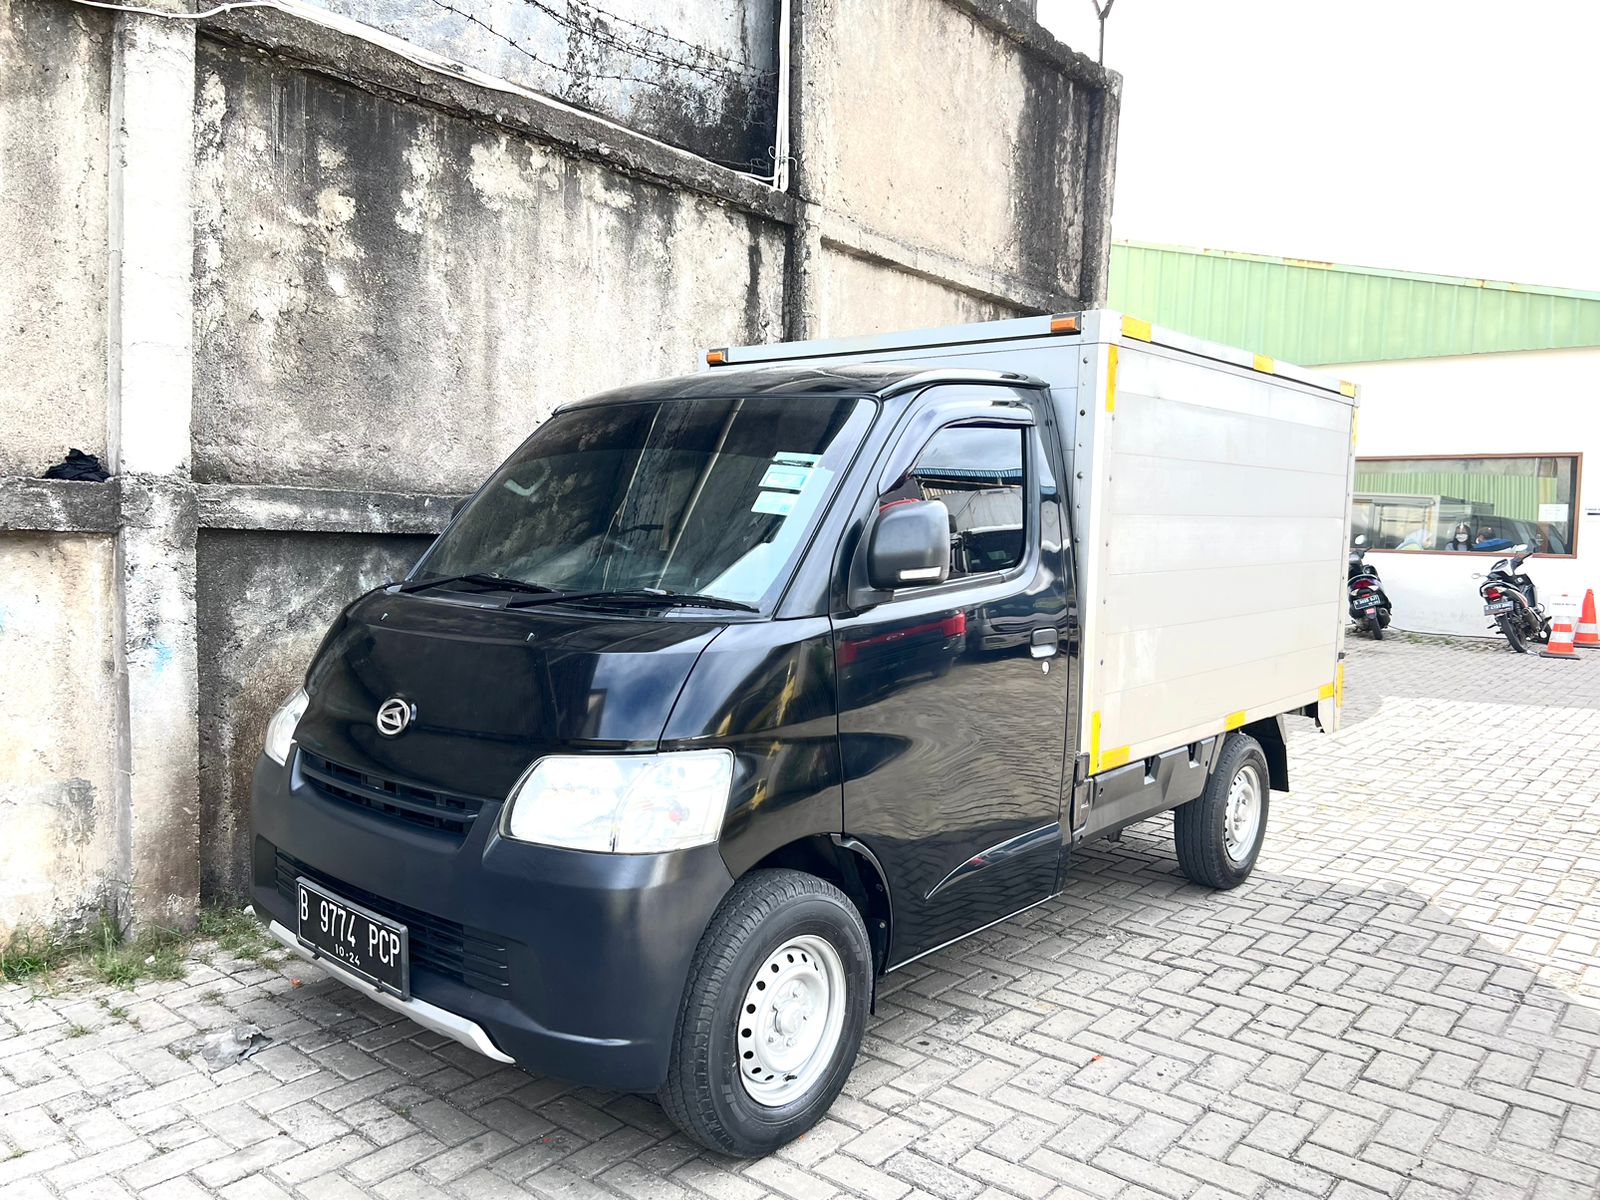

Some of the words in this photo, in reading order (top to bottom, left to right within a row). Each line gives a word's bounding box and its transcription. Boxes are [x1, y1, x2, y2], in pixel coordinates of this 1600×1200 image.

[300, 888, 309, 921] B
[320, 900, 356, 947] 9774
[368, 923, 400, 968] PCP
